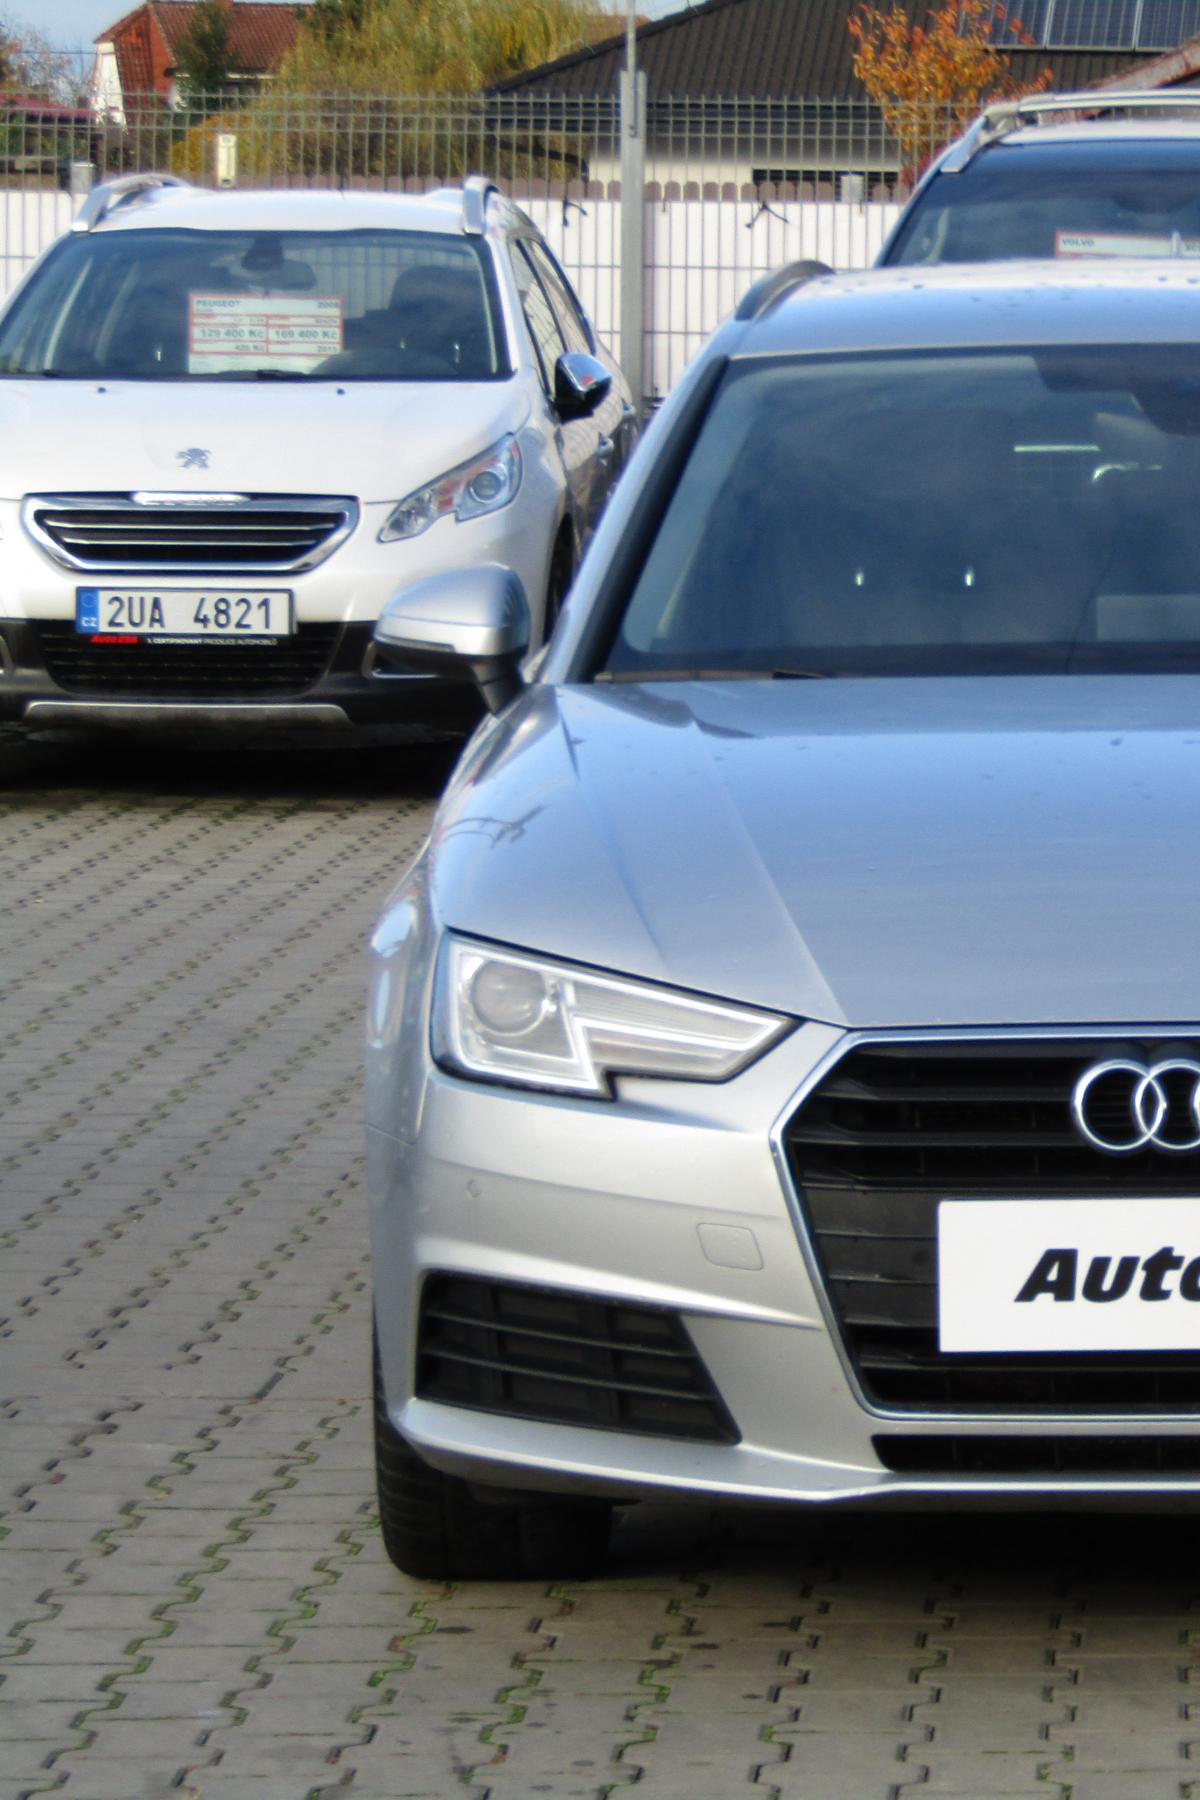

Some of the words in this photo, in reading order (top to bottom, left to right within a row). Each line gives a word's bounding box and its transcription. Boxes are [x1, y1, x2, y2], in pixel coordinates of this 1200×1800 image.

[1062, 239, 1094, 247] VOLVO
[196, 300, 240, 308] PEUGEOT
[224, 329, 246, 338] 400
[298, 330, 319, 339] 400
[107, 596, 165, 628] 2UA
[194, 597, 271, 629] 4821
[81, 617, 98, 627] CZ
